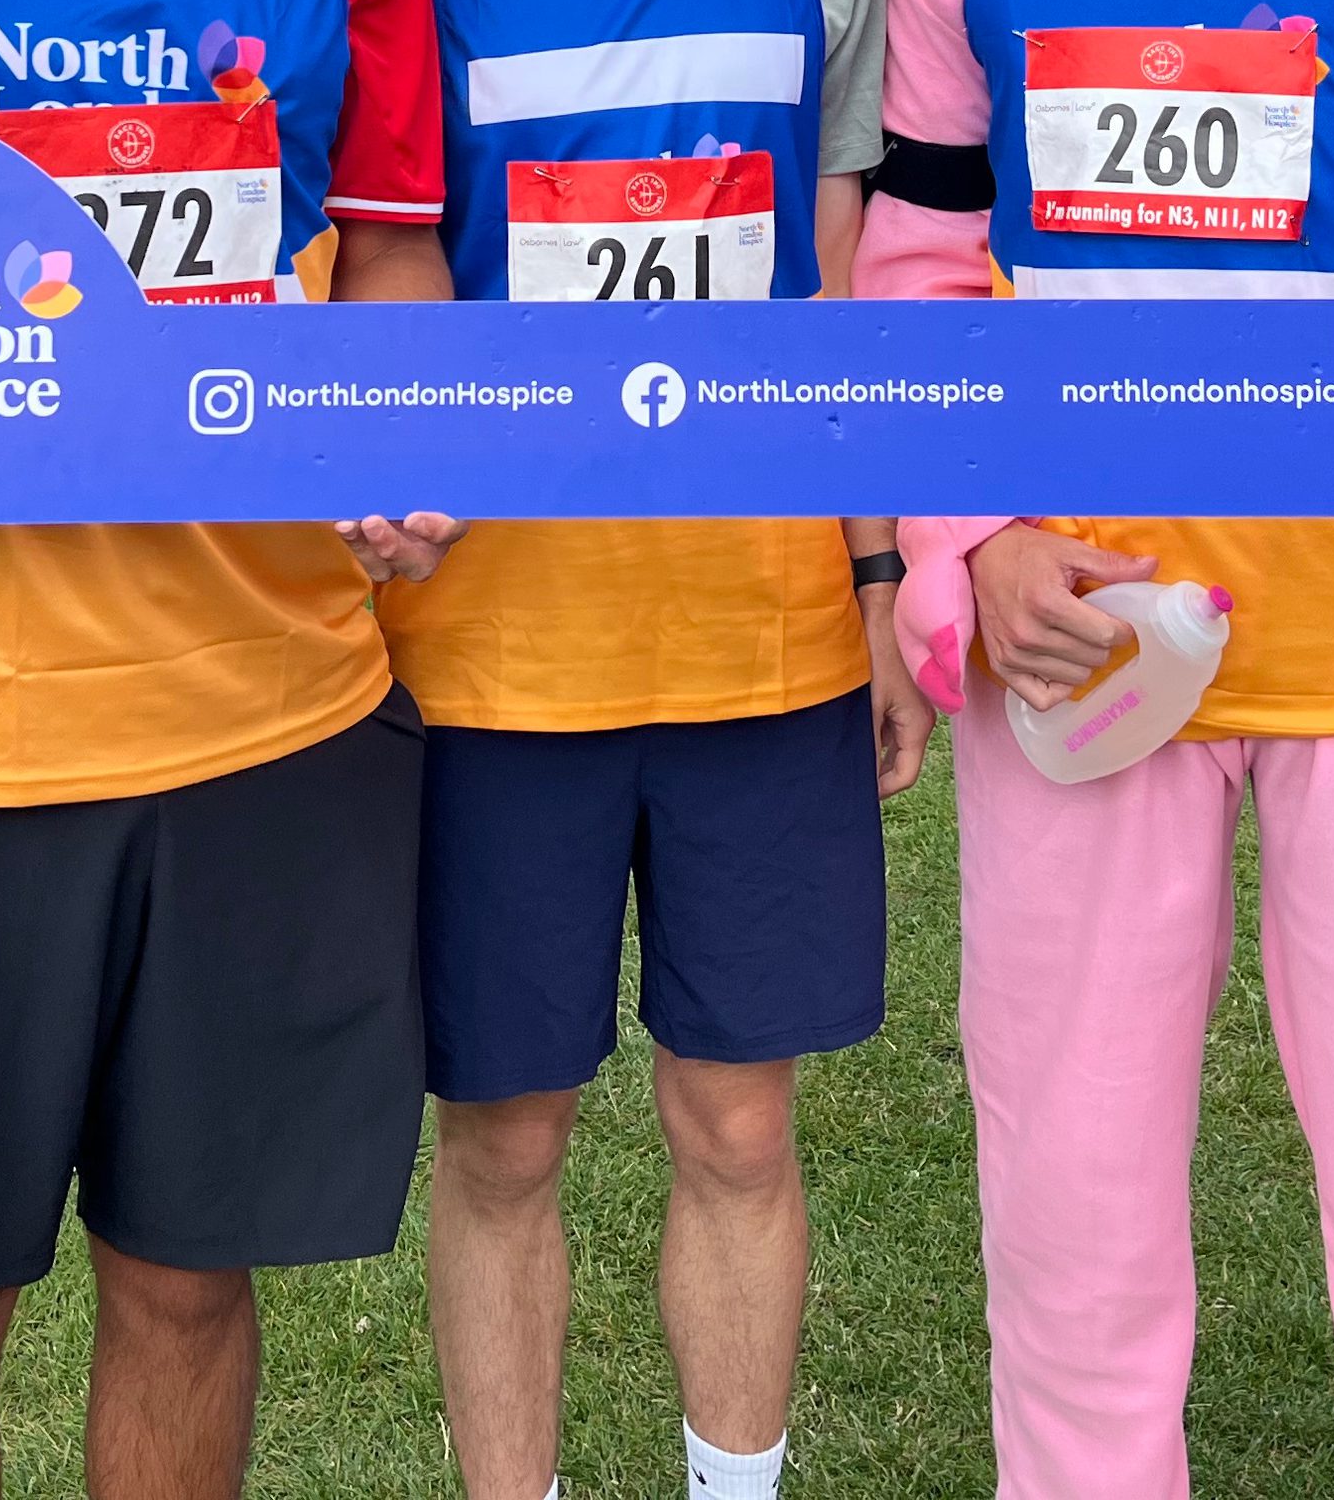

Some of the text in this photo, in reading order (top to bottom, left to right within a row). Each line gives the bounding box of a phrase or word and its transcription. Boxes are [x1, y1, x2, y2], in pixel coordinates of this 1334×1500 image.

[1095, 103, 1238, 189] 260
[1066, 204, 1132, 228] running
[1137, 203, 1163, 224] for
[1168, 205, 1199, 229] N3,
[1251, 209, 1288, 230] N12
[586, 234, 711, 301] 261
[267, 380, 573, 412] NorthLondonHospice
[698, 377, 1005, 409] NorthLondonHospice
